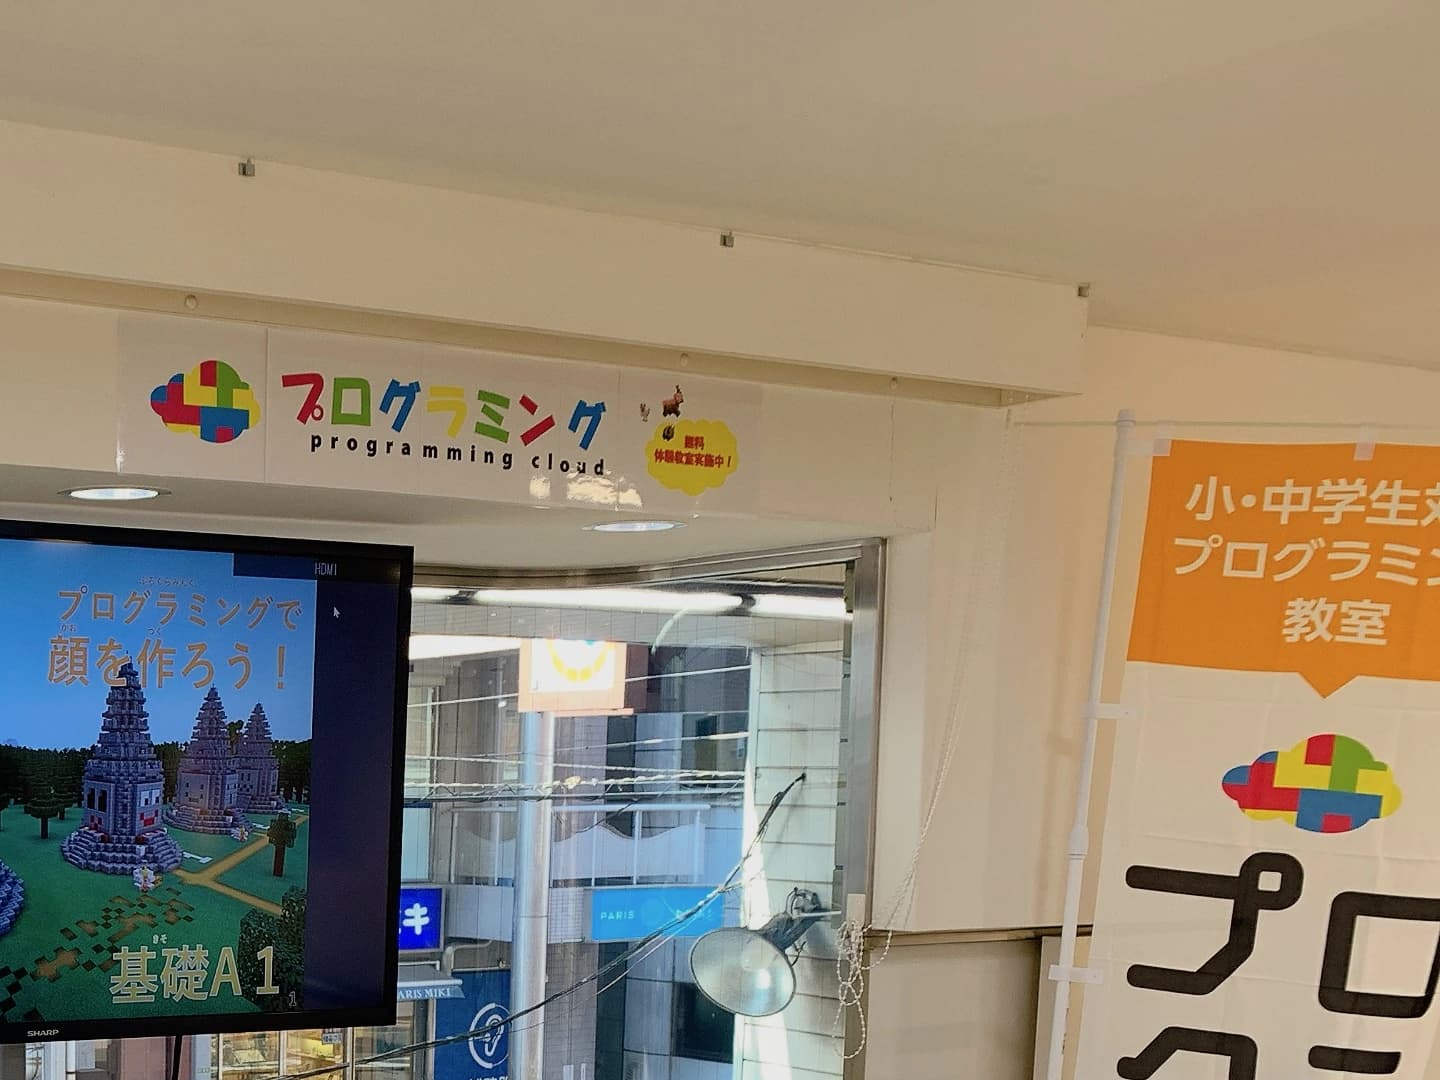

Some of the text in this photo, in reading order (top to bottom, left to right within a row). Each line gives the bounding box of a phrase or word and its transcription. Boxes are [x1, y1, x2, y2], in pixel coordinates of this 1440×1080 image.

[281, 372, 606, 451] プログラミング
[310, 434, 605, 475] programming cloud
[314, 562, 337, 576] HDMI
[58, 584, 303, 631] プログラミングで
[1282, 596, 1391, 646] 教室
[47, 634, 285, 690] 顔を作ろう！
[399, 903, 430, 936] キ
[600, 911, 635, 920] PARIS
[288, 990, 297, 1007] 1
[424, 987, 450, 998] MIKI
[26, 1029, 59, 1037] SHARP
